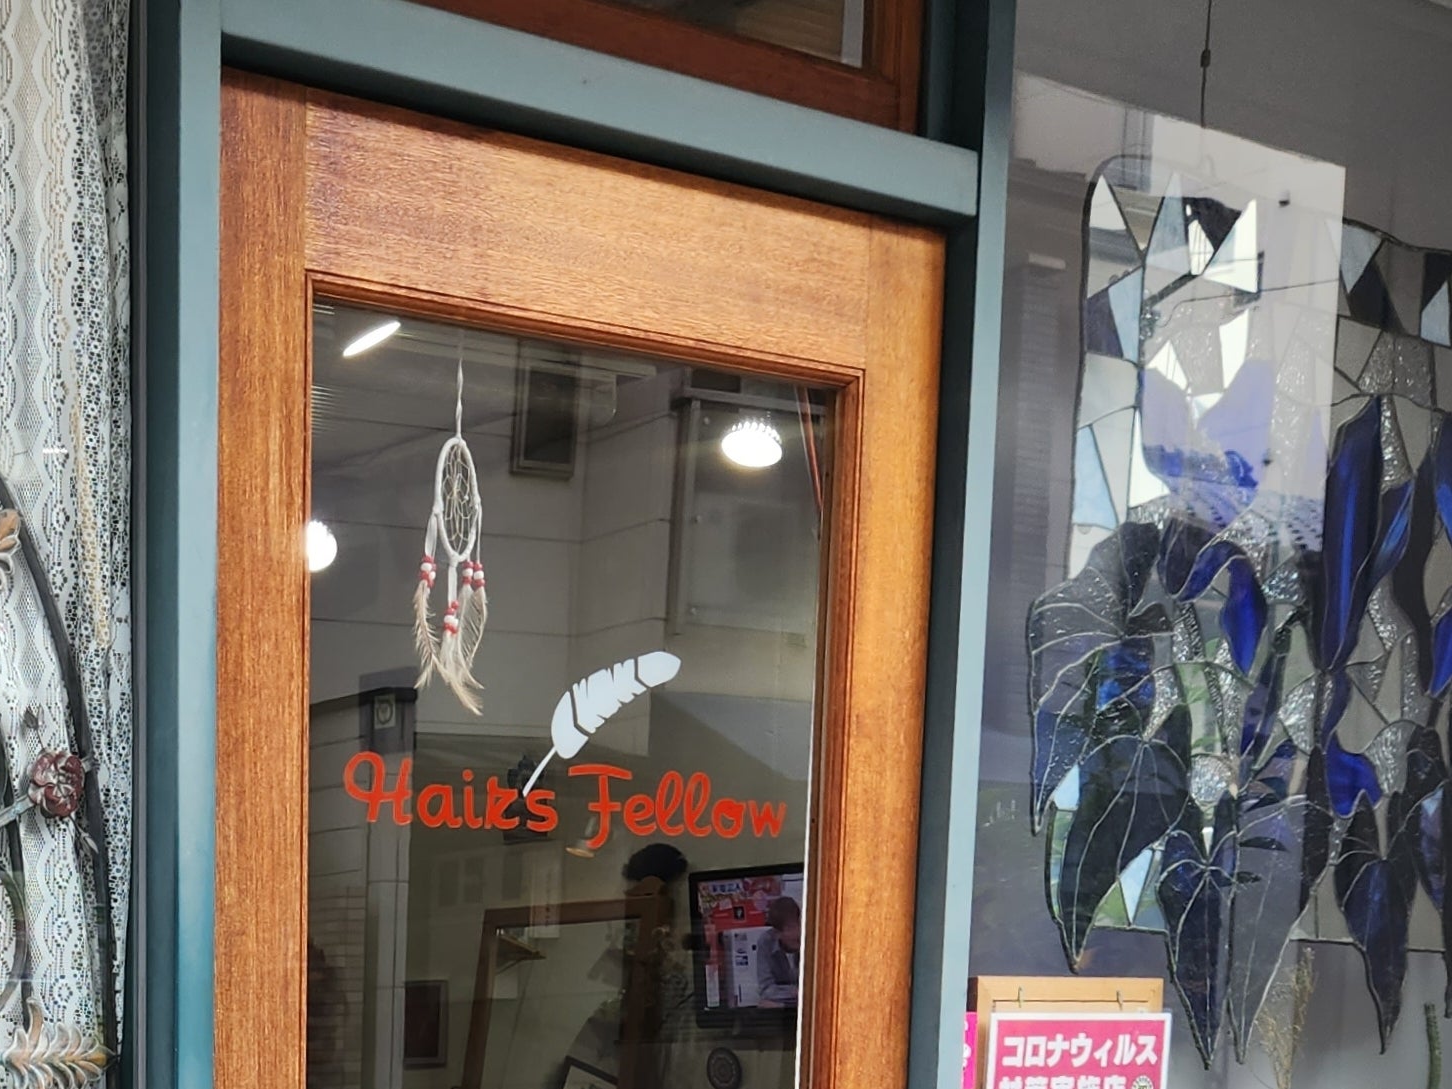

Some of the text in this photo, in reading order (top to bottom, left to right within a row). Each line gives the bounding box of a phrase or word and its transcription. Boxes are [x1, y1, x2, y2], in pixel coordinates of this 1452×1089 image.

[567, 763, 788, 852] Fellow
[1002, 1033, 1158, 1068] コロナウィルス
